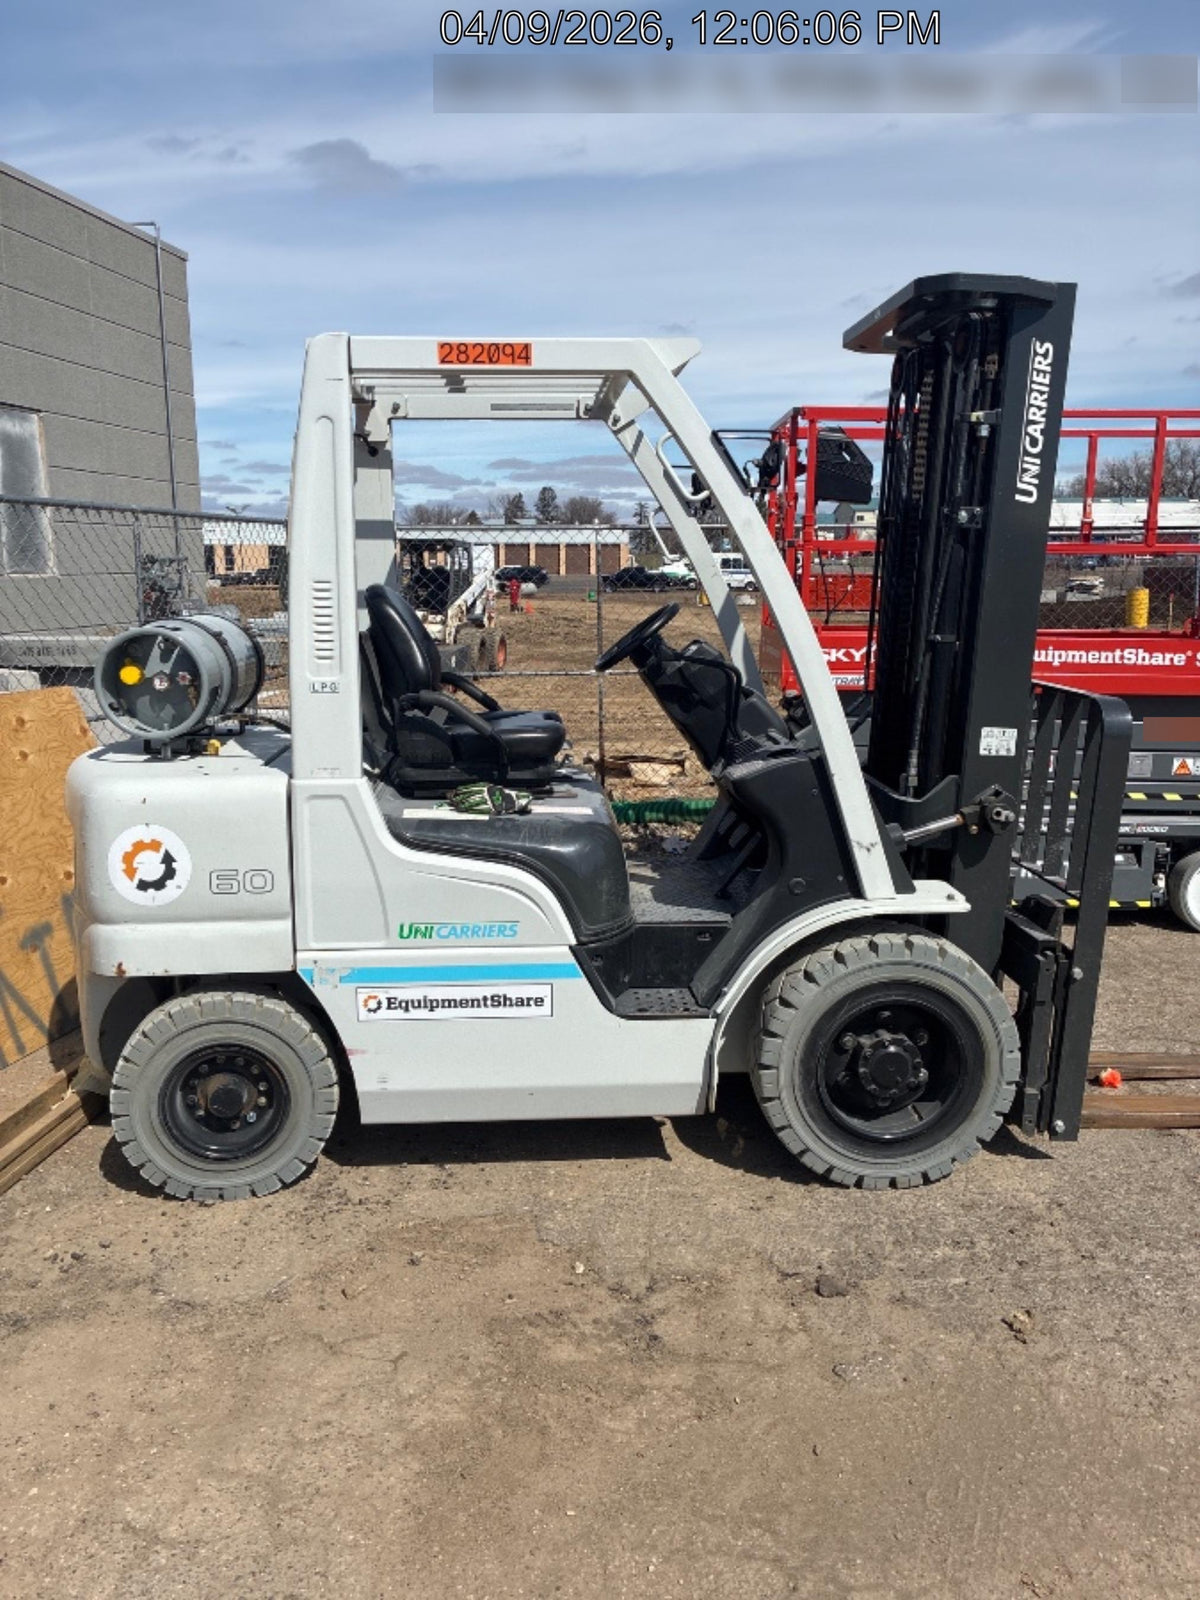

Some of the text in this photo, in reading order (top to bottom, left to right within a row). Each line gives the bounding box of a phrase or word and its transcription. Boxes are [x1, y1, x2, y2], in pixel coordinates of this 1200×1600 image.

[440, 342, 531, 364] 282094
[1015, 338, 1054, 504] UNICARRIERS
[820, 646, 876, 663] SKY
[1034, 647, 1186, 666] uipmentShare
[209, 869, 274, 895] 60
[399, 921, 518, 939] UNICARRIERS
